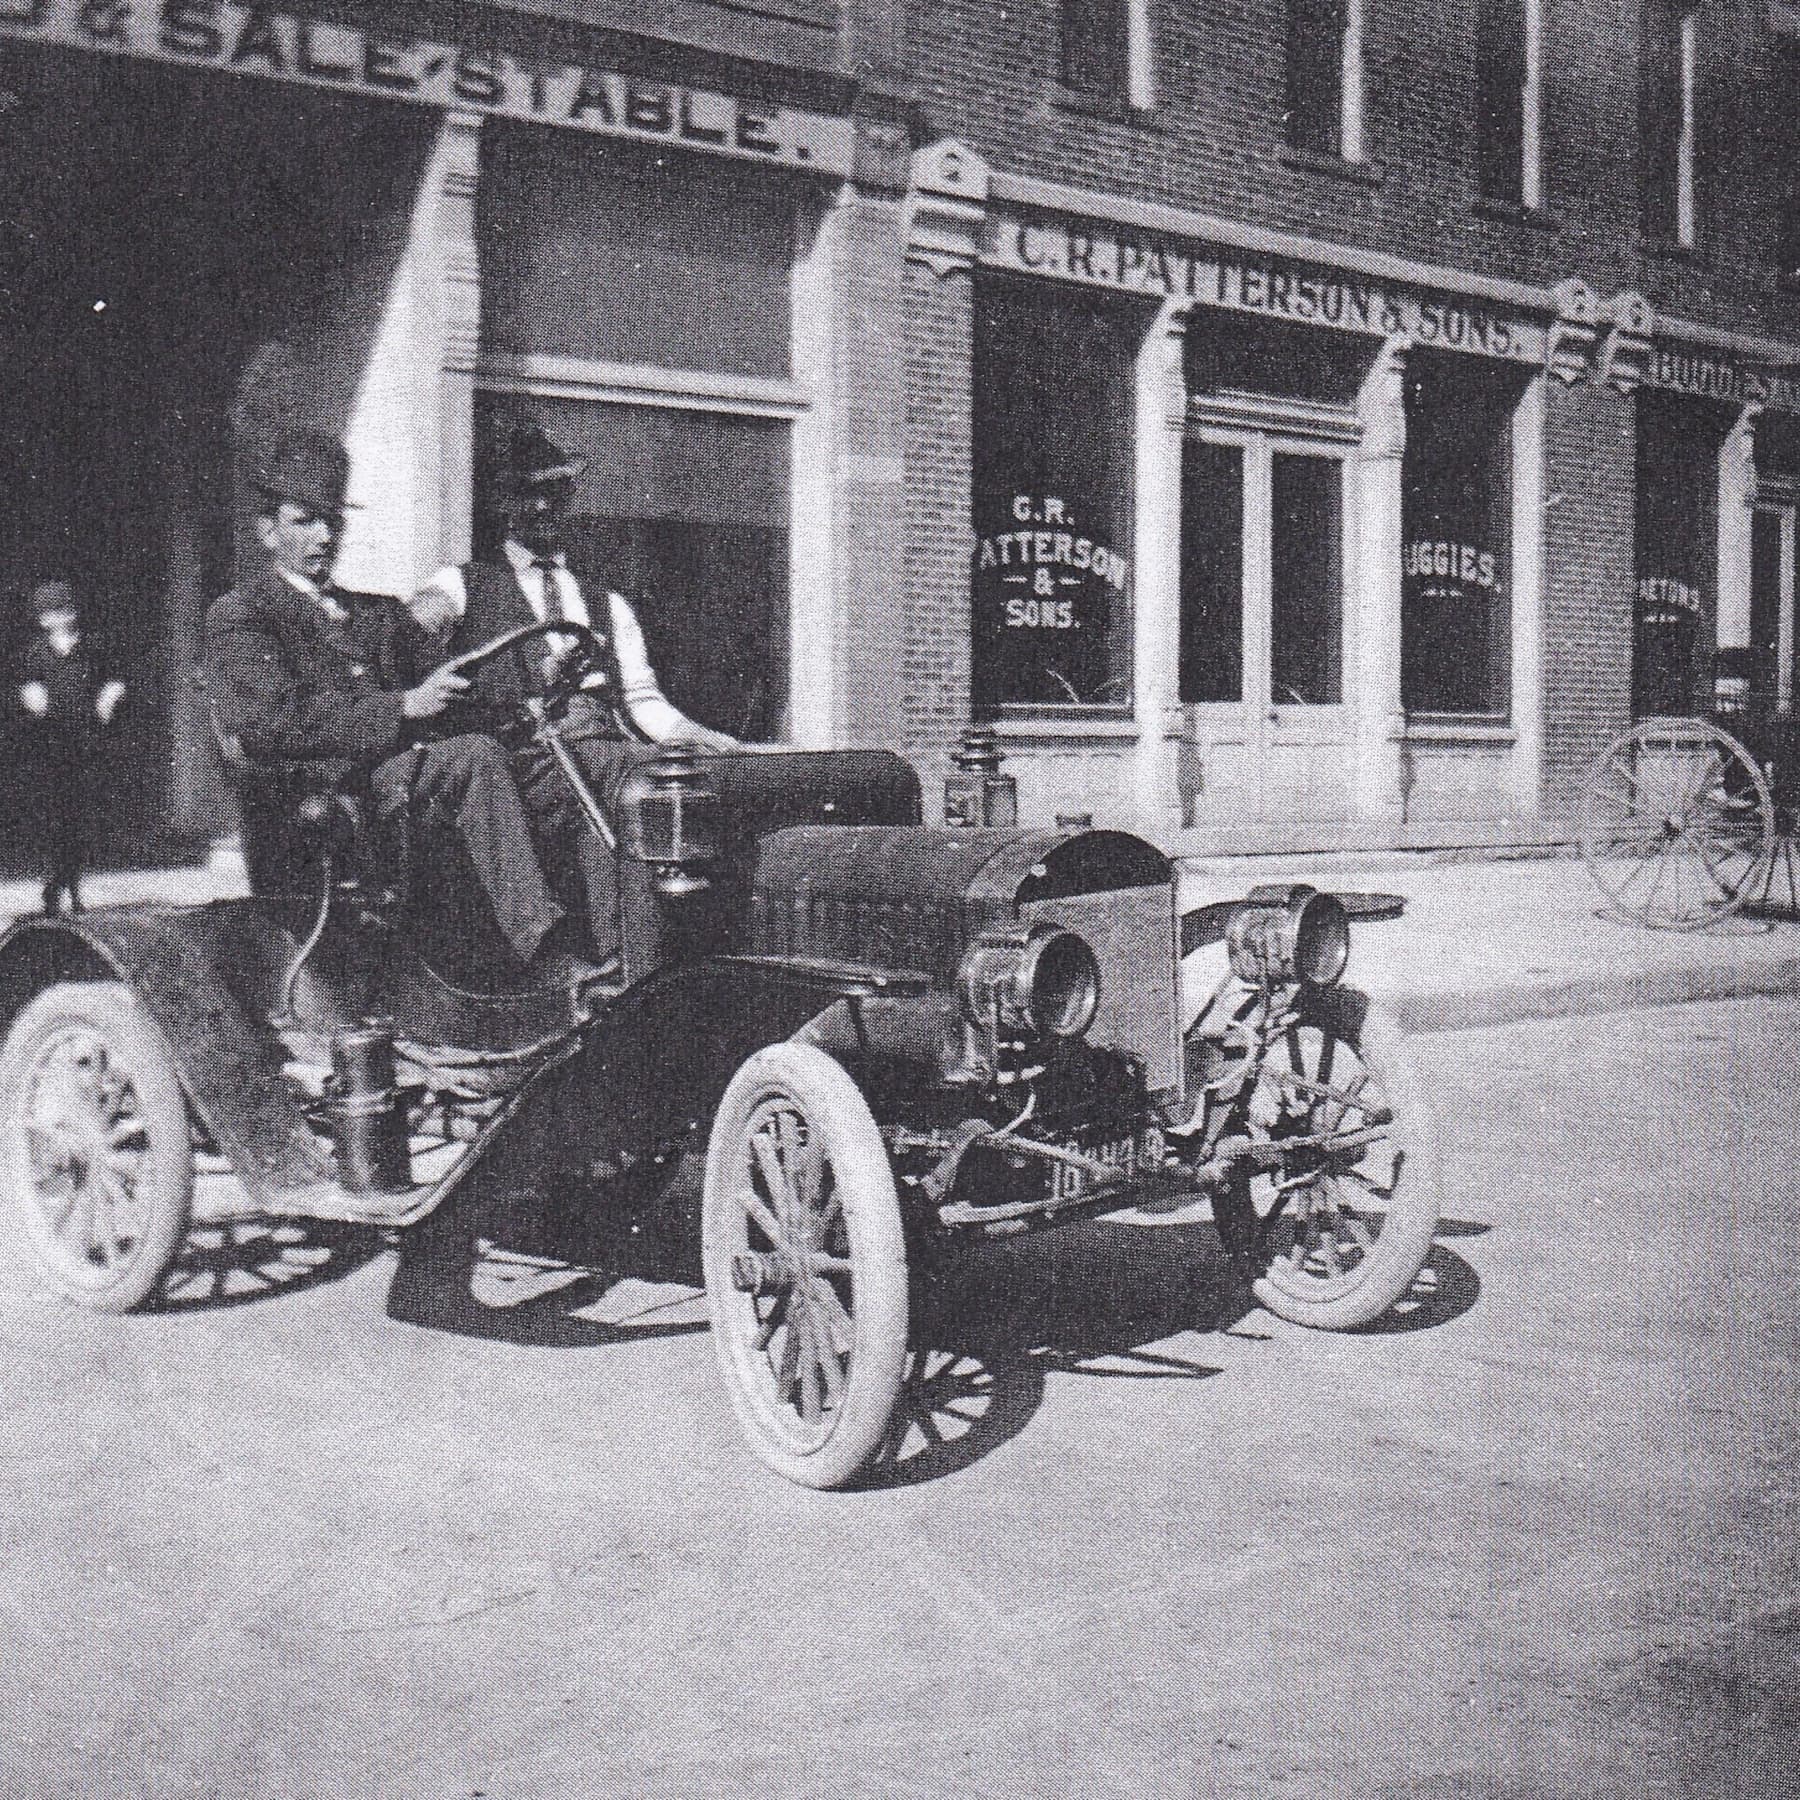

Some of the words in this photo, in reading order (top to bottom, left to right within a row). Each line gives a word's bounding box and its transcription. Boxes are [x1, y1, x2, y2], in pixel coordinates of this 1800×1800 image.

[160, 1, 419, 91] SALE
[1116, 242, 1372, 328] PATTERSON
[1381, 293, 1410, 334] &
[1418, 302, 1523, 356] SONS.
[978, 529, 1127, 592] ATTERSON
[1403, 540, 1502, 594] UGGIES.
[1005, 598, 1081, 629] SONS.
